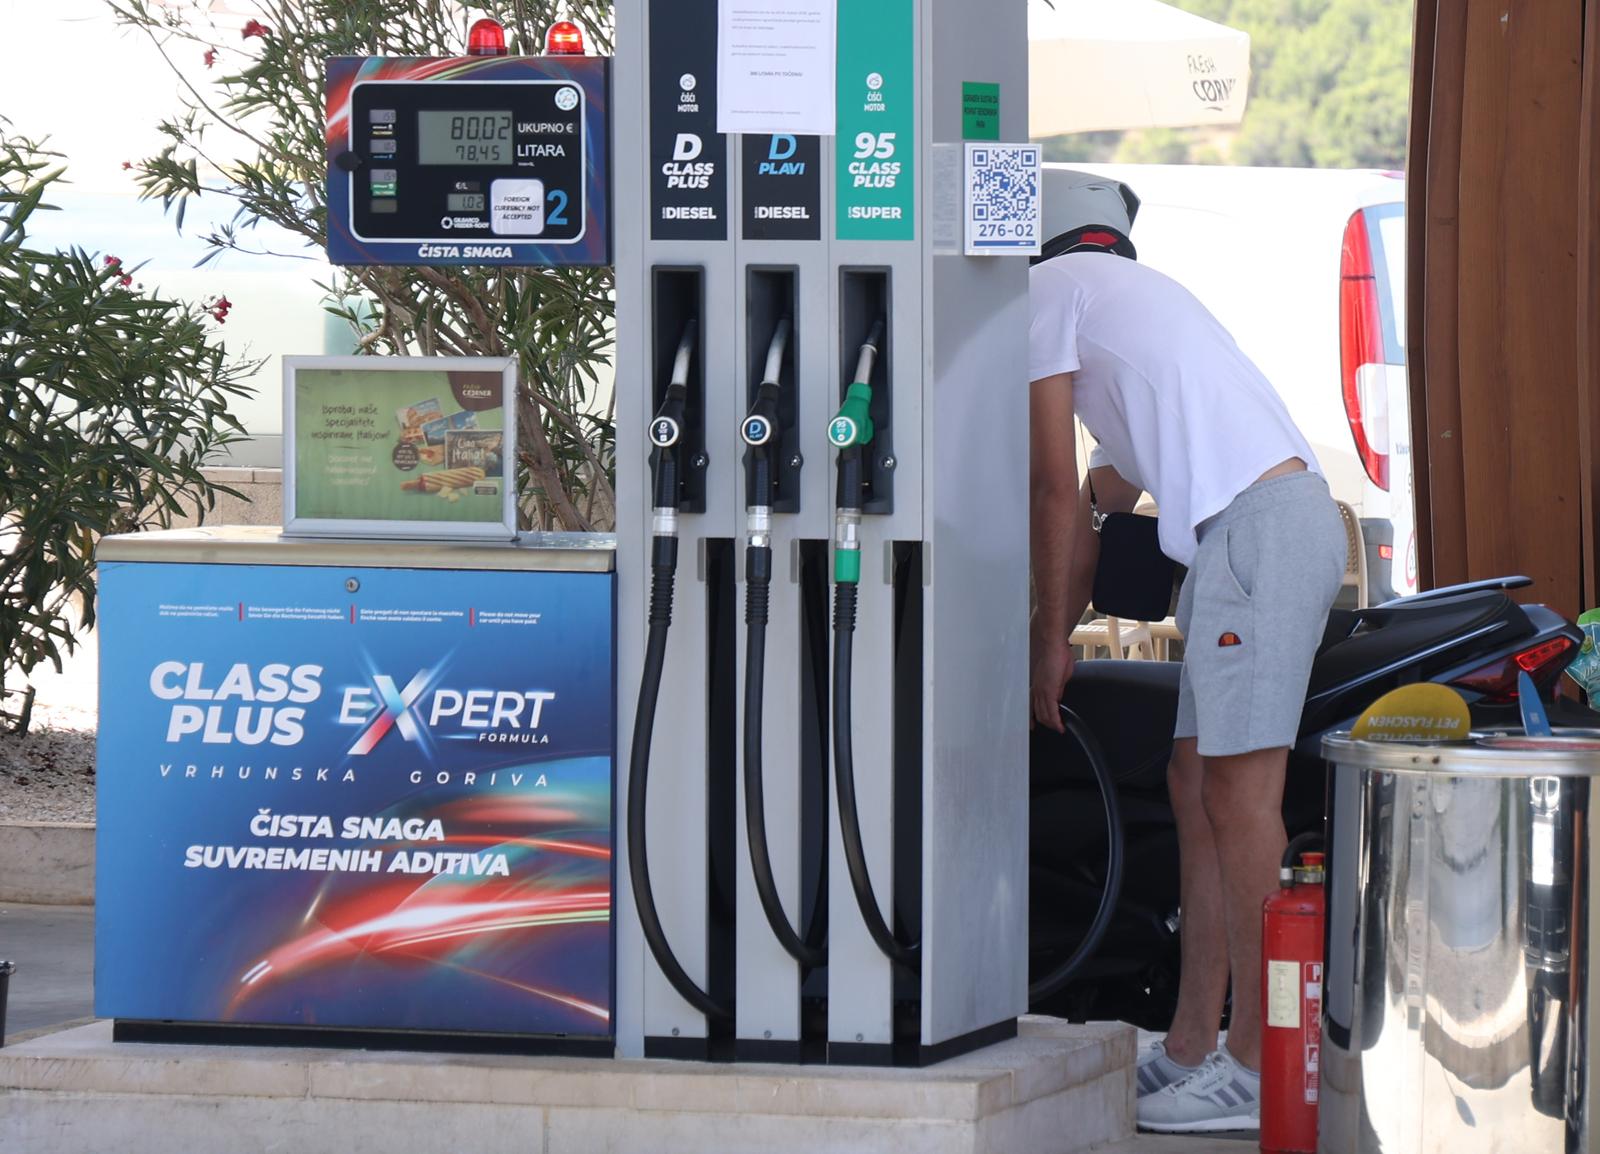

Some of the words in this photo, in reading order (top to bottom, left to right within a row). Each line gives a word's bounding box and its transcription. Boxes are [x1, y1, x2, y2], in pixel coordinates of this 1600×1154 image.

[677, 104, 699, 112] MOTOR
[864, 103, 886, 112] MOTOR
[517, 123, 564, 133] UKUPNO
[566, 123, 573, 133] €
[517, 145, 566, 157] LITARA
[672, 133, 702, 160] D
[768, 134, 797, 160] D
[853, 132, 896, 159] 95
[662, 162, 714, 176] CLASS
[758, 163, 805, 175] PLAVI
[848, 162, 901, 175] CLASS
[667, 176, 709, 189] PLUS
[853, 175, 896, 188] PLUS
[546, 189, 568, 225] 2
[665, 207, 717, 219] DIESEL
[758, 206, 810, 219] DIESEL
[851, 206, 902, 219] SUPER
[979, 224, 1033, 237] 276-02
[418, 243, 460, 258] ČISTA
[463, 246, 512, 258] SNAGA
[750, 422, 761, 433] D
[149, 661, 323, 704] CLASS
[165, 704, 306, 746] PLUS
[1367, 716, 1434, 728] FLASCHEN
[1433, 717, 1460, 729] PET
[478, 732, 550, 745] FORMULA
[159, 764, 356, 782] VRHUNSKA
[410, 769, 549, 787] GORIVA
[249, 808, 336, 839] ČISTA
[341, 816, 445, 842] SNAGA
[183, 845, 383, 873] SUVREMENIH
[387, 850, 511, 877] ADITIVA
